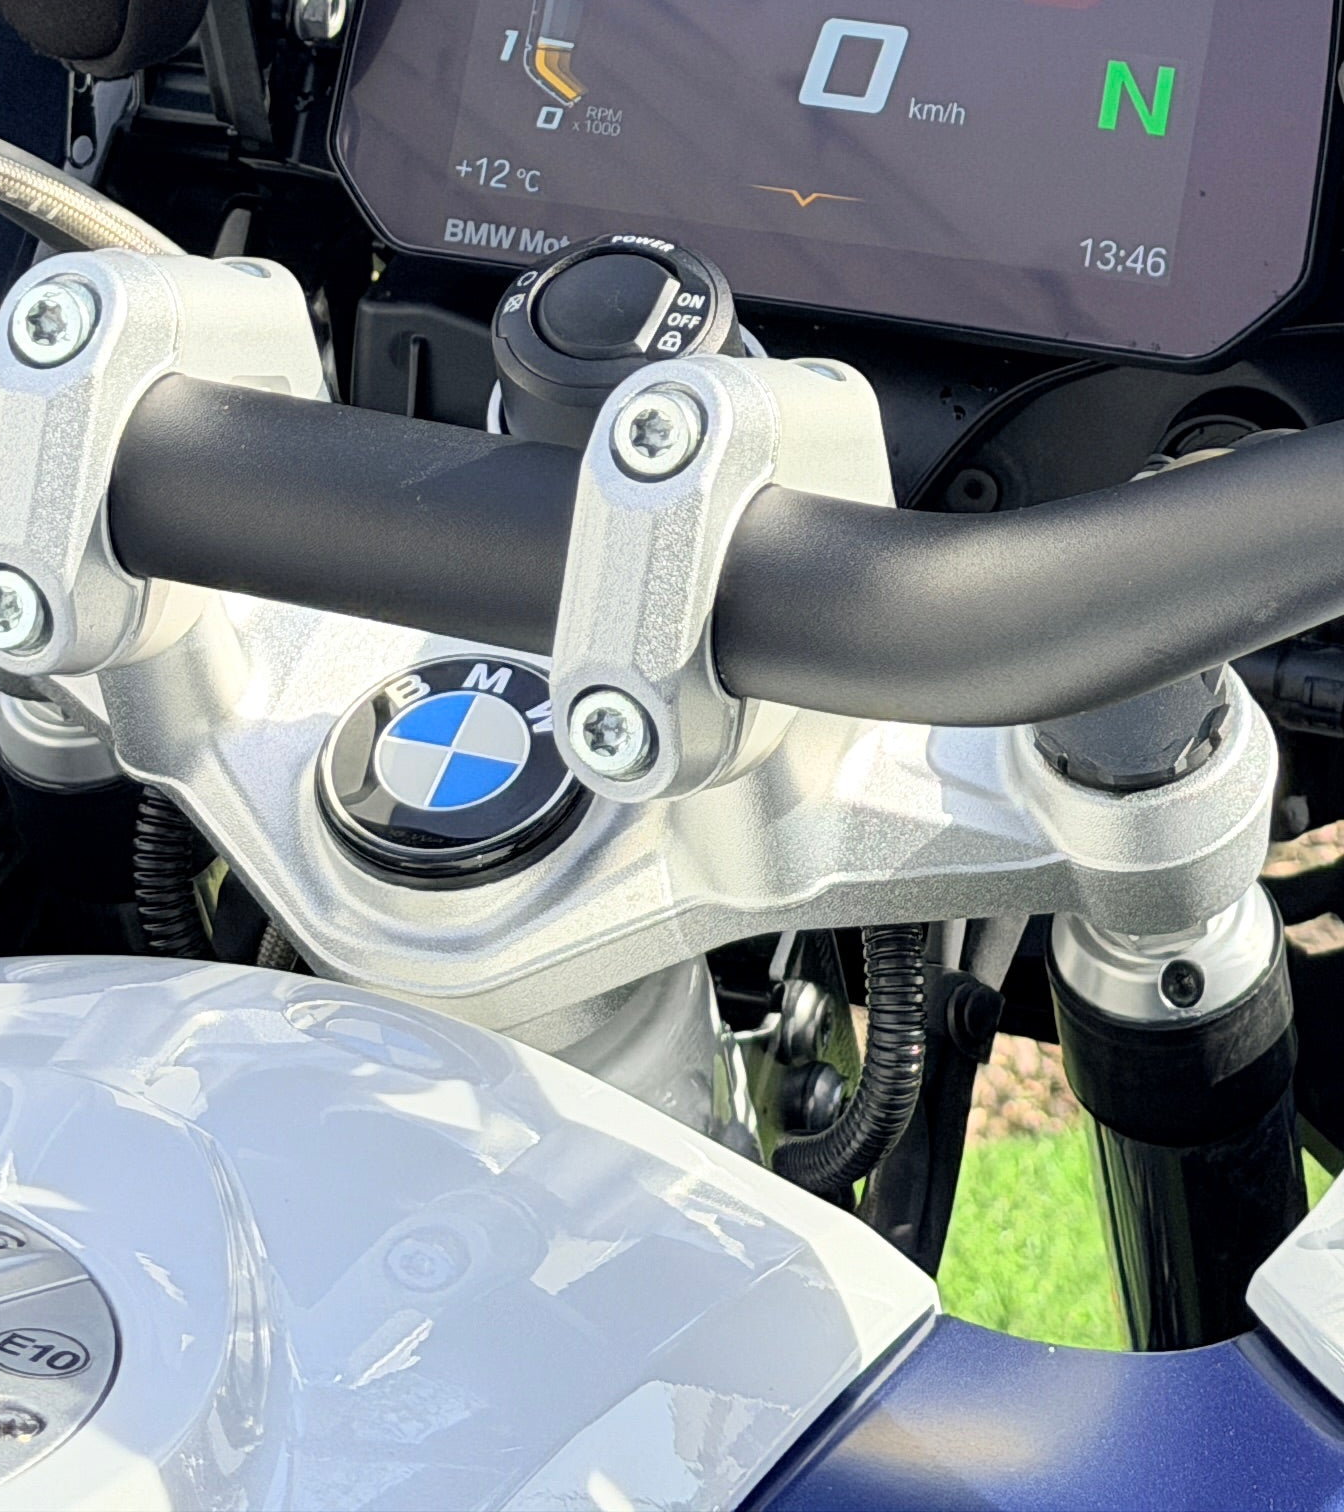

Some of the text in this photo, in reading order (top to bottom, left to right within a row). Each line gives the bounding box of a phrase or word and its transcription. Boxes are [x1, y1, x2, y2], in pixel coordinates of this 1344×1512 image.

[500, 29, 519, 61] 1
[798, 18, 966, 125] 0 km/h
[1097, 59, 1176, 136] N
[536, 106, 563, 130] 0
[585, 120, 621, 136] 1000
[586, 106, 623, 123] RPM
[444, 219, 517, 249] BMW
[612, 235, 675, 252] POWER
[1079, 237, 1167, 277] 13:46
[677, 293, 706, 309] ON
[668, 313, 702, 329] OFF
[384, 662, 553, 734] BMW
